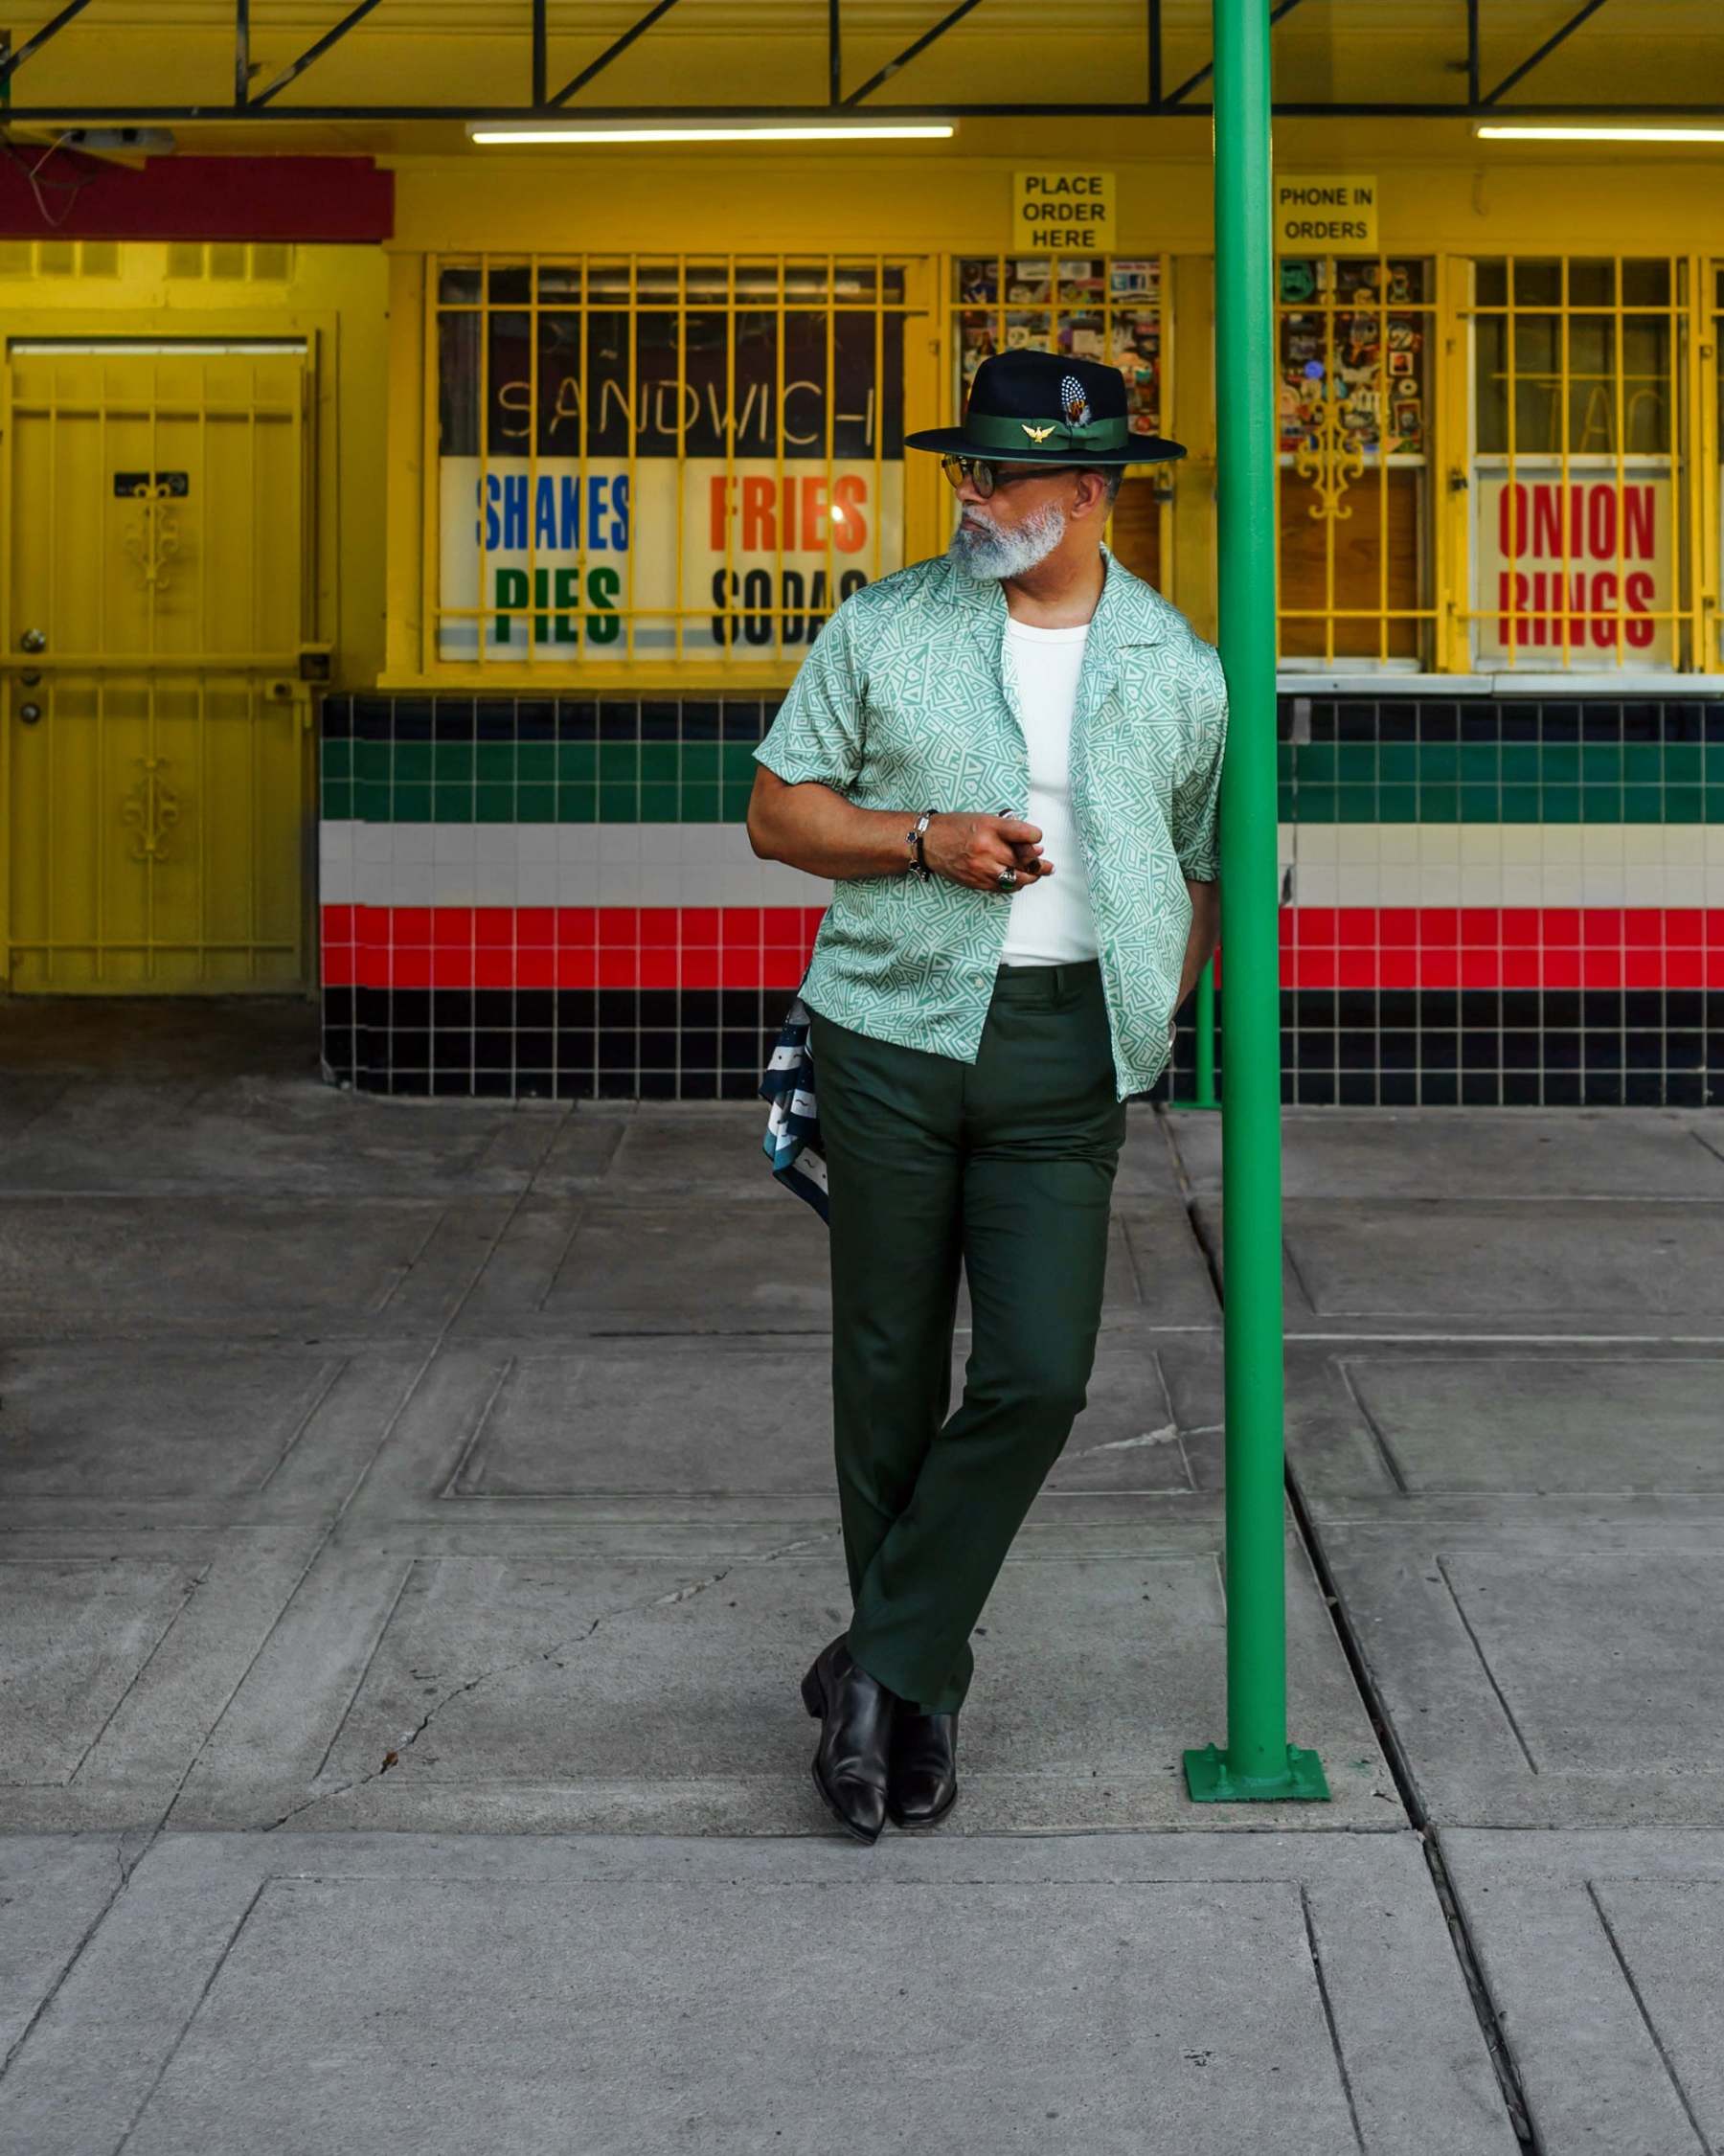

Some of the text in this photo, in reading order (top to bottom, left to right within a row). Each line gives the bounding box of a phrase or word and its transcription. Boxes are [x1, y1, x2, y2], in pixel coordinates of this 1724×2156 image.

[1023, 203, 1105, 221] ORDER
[1026, 176, 1102, 195] PLACE
[1280, 188, 1372, 206] PHONE IN
[1032, 229, 1096, 248] HERE
[1285, 221, 1368, 239] ORDERS
[498, 376, 874, 446] SANDWICH
[476, 473, 631, 552] SHAKES
[711, 475, 867, 555] FRIES
[1499, 483, 1655, 560] ONION
[495, 567, 621, 645] PIES
[1499, 571, 1655, 648] RINGS
